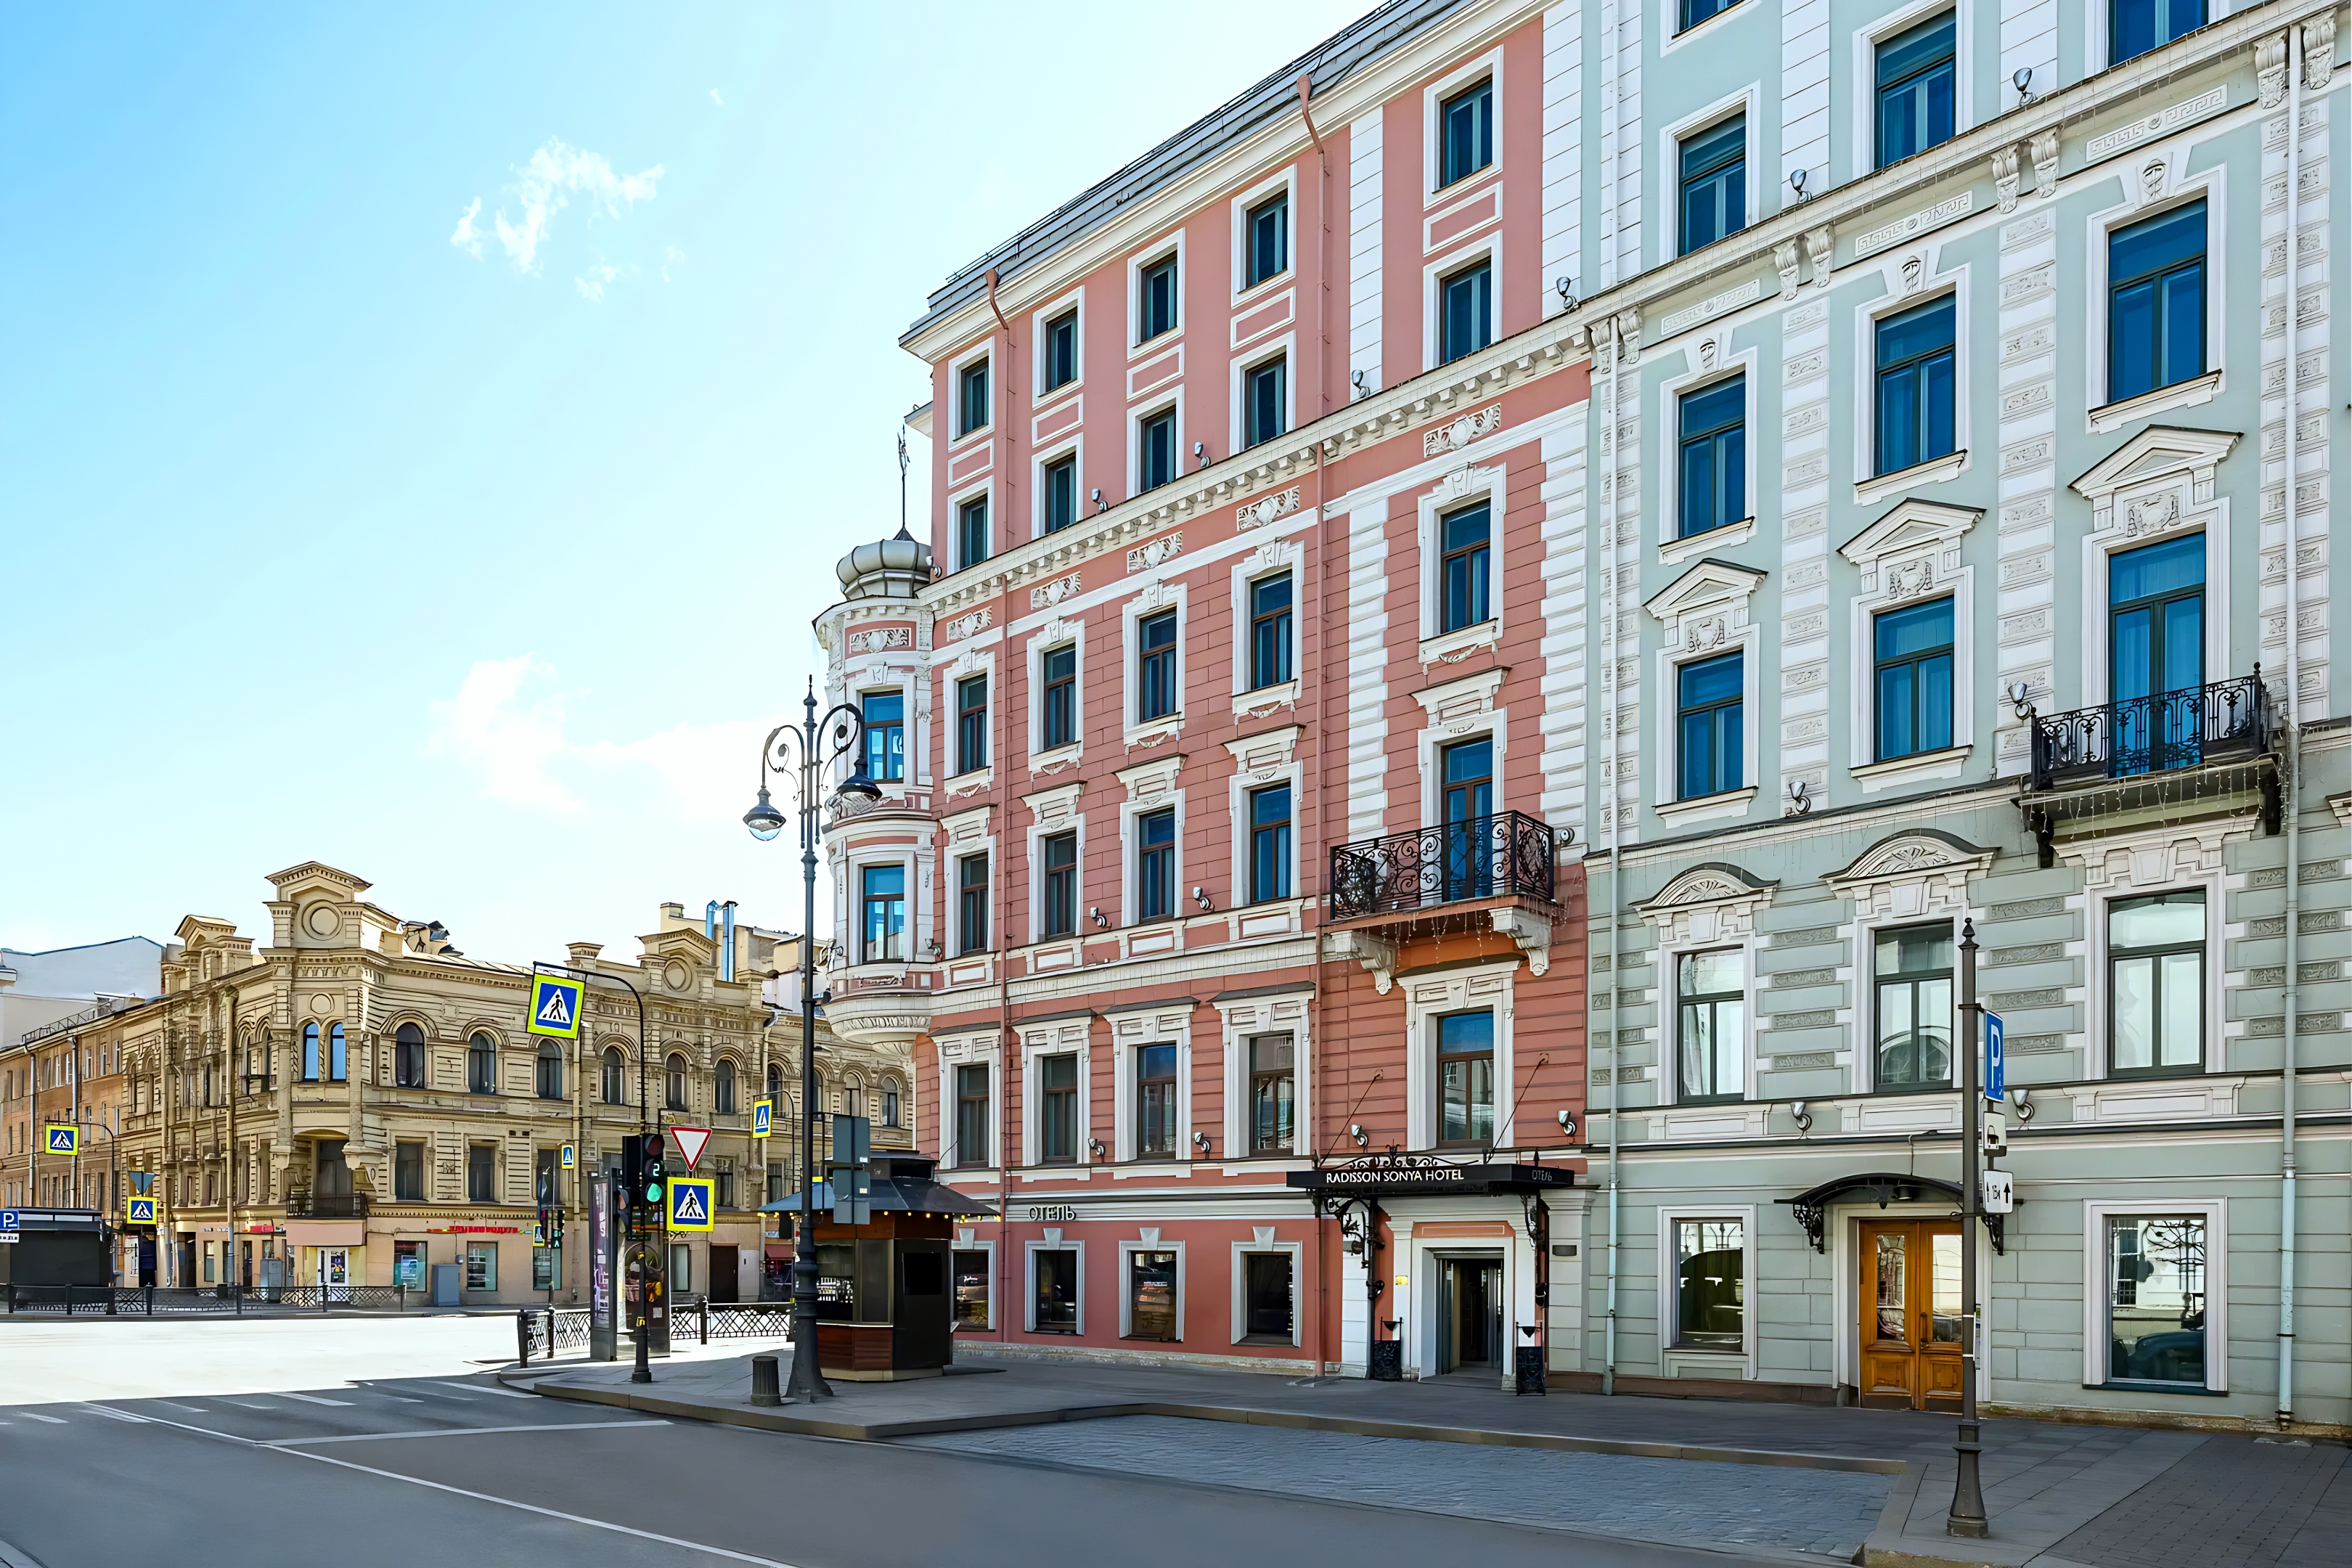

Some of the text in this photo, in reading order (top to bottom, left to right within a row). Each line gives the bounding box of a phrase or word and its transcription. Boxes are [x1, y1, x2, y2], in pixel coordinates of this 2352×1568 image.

[1991, 1024, 2001, 1089] P
[1326, 1169, 1464, 1183] RADISSON SONYA HOTEL
[3, 1212, 15, 1228] P
[1029, 1205, 1077, 1221] ОТЕЛЬ
